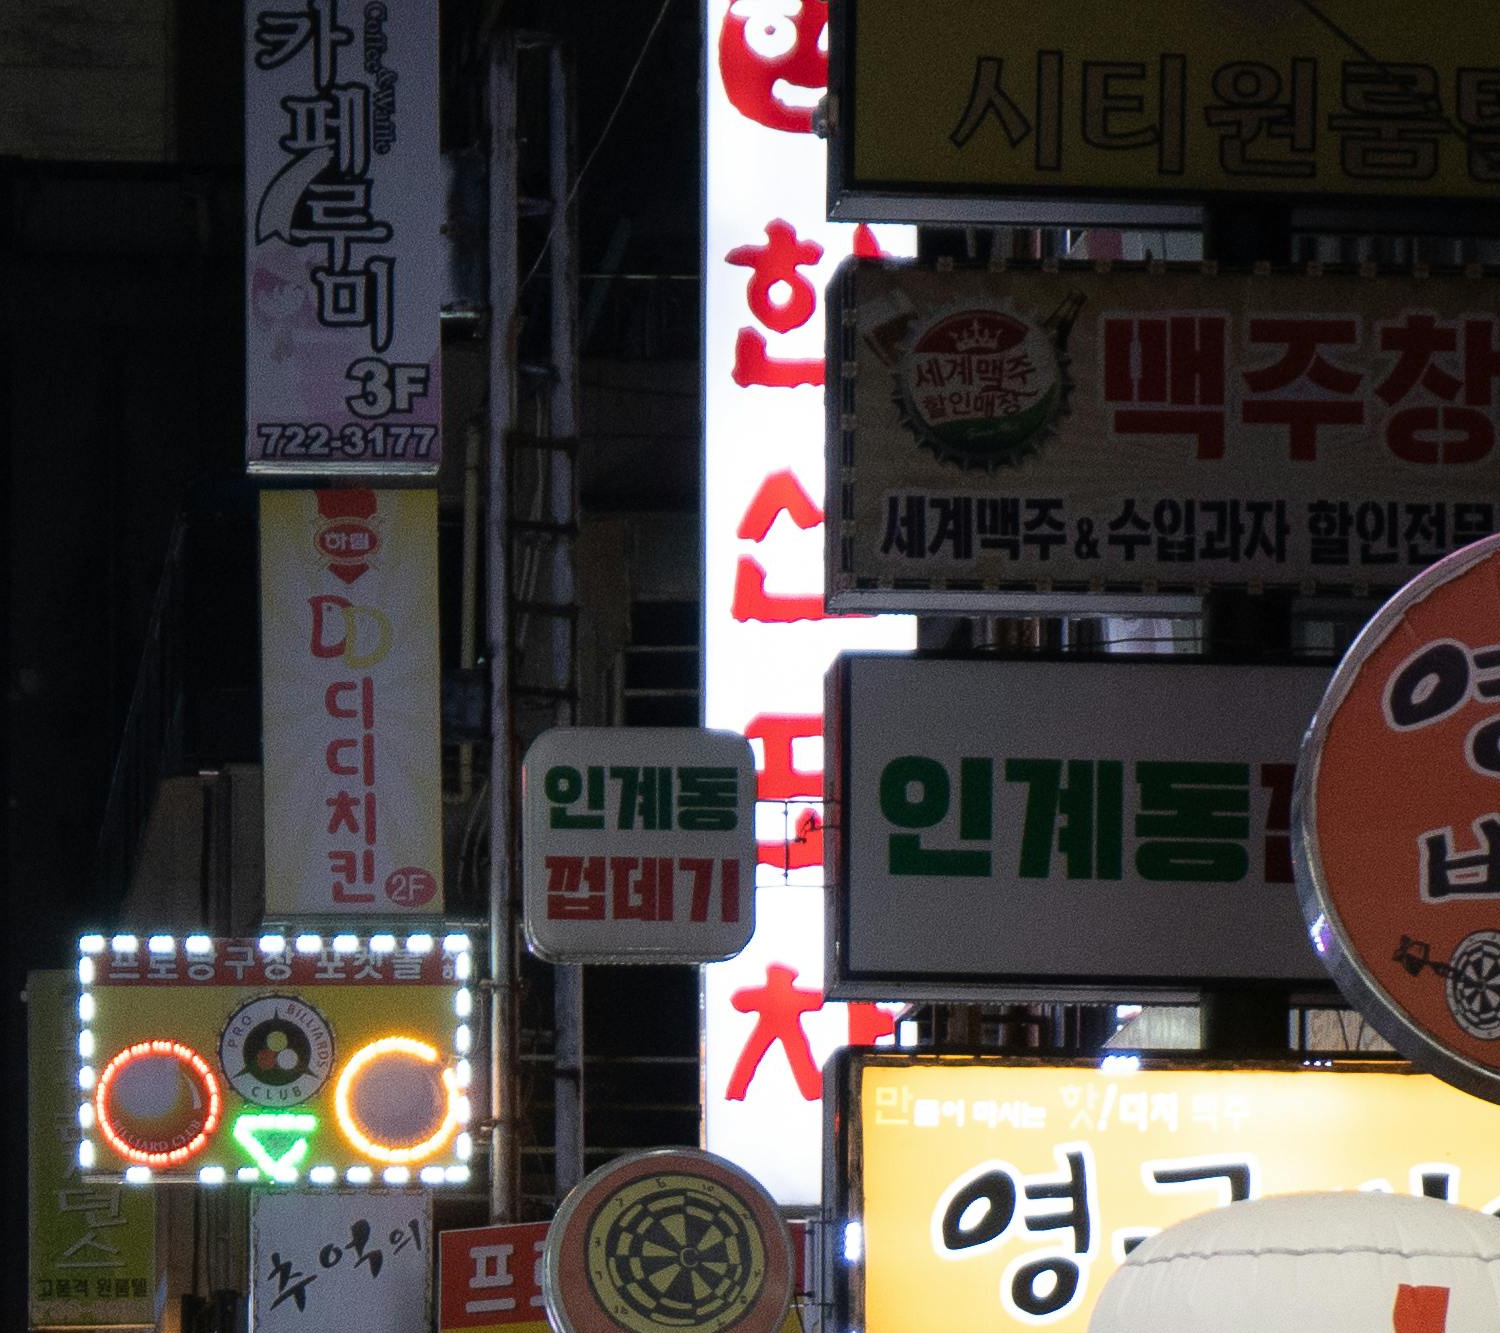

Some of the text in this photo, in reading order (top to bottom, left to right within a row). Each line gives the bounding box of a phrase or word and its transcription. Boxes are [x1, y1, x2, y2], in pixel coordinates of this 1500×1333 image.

[345, 357, 430, 418] 3F
[257, 424, 437, 457] 722-3177
[880, 496, 1068, 562] 세계맥주
[1107, 498, 1290, 564] 수입과자
[325, 676, 376, 903] 디디치킨
[544, 764, 740, 832] 인계동
[544, 854, 740, 926] 껍데기
